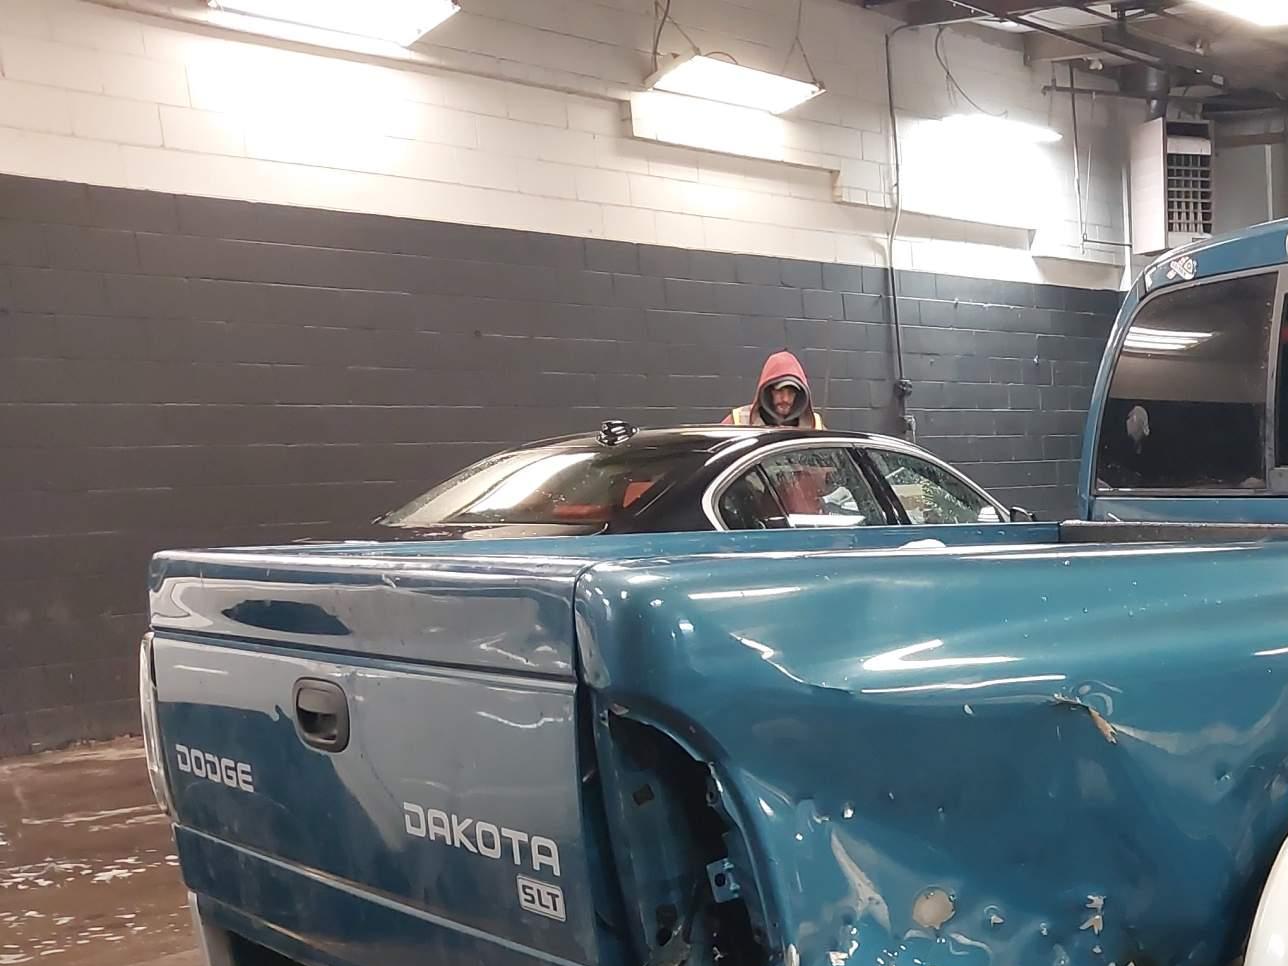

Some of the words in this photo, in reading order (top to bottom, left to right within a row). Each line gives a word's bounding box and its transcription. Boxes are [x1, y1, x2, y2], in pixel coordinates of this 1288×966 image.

[176, 744, 255, 793] DODGE
[403, 801, 561, 877] DAKOTA
[521, 884, 560, 912] SLT
